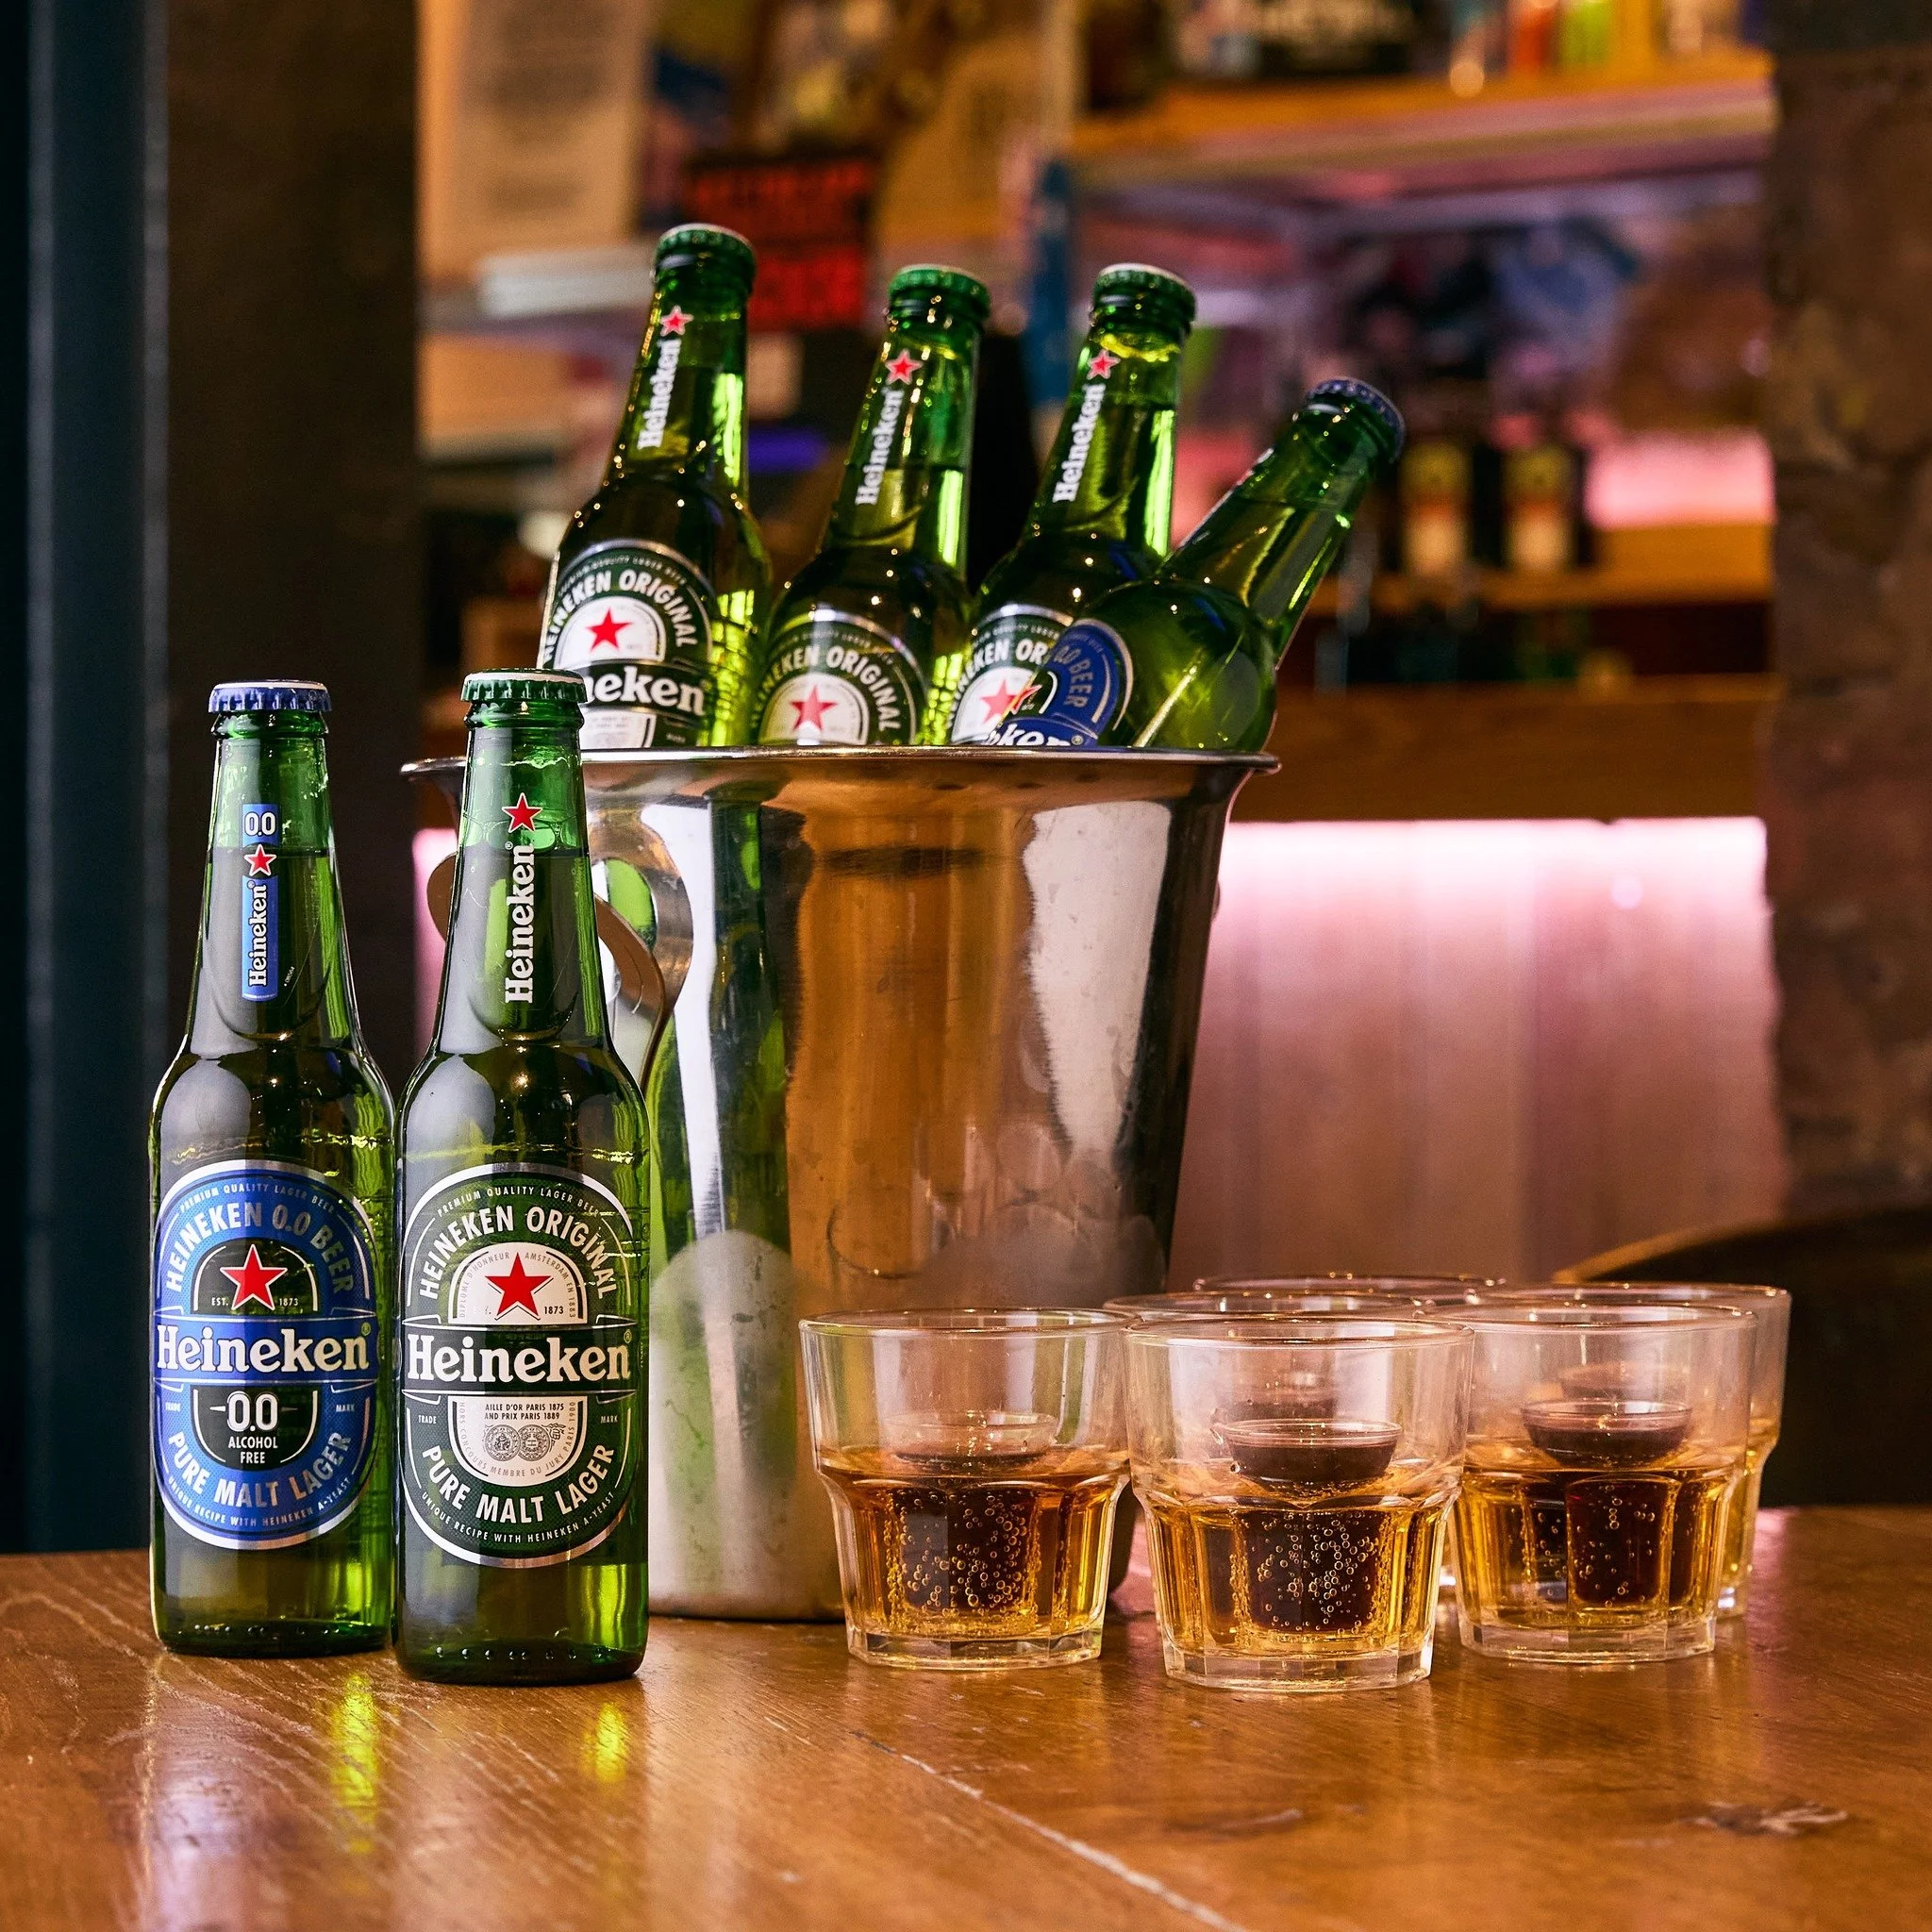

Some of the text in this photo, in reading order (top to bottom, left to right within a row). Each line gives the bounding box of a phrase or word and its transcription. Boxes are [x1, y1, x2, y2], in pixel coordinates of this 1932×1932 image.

[618, 569, 699, 648] ORIGINAL
[825, 645, 901, 732] ORIGINAL
[1063, 659, 1093, 708] BEER
[244, 812, 276, 836] 0.0
[223, 1183, 269, 1194] QUALITY
[275, 1185, 308, 1200] LAGER
[311, 1195, 336, 1214] BEER
[437, 1187, 600, 1218] PREMIUM QUALITY LAGER BEER
[166, 1202, 354, 1294] HEINEKEN 0.0 BEER
[420, 1205, 617, 1300] HEINEKEN ORIGINAL
[525, 1253, 569, 1280] AMSTERDAM
[211, 1297, 299, 1307] EST. 1873
[566, 1282, 575, 1293] EN
[543, 1306, 564, 1314] 1873
[568, 1297, 576, 1318] 1883
[227, 1391, 278, 1432] 0.0
[336, 1404, 356, 1412] MARK
[418, 1415, 618, 1424] TRADE MARK
[228, 1436, 278, 1449] ALCOHOL
[240, 1451, 266, 1464] FREE
[490, 1466, 525, 1476] MEMBRE
[545, 1454, 564, 1470] JURY
[563, 1426, 575, 1453] PARIS
[168, 1431, 352, 1507] PURE MALT LAGER
[422, 1443, 615, 1524] PURE MALT LAGER
[193, 1504, 226, 1524] RECIPE
[230, 1516, 257, 1527] WITH
[261, 1507, 314, 1527] HEINEKEN
[318, 1476, 351, 1511] A-YEAST
[422, 1491, 613, 1543] UNIQUE RECIPE WITH HEINEKEN A-YEAST
